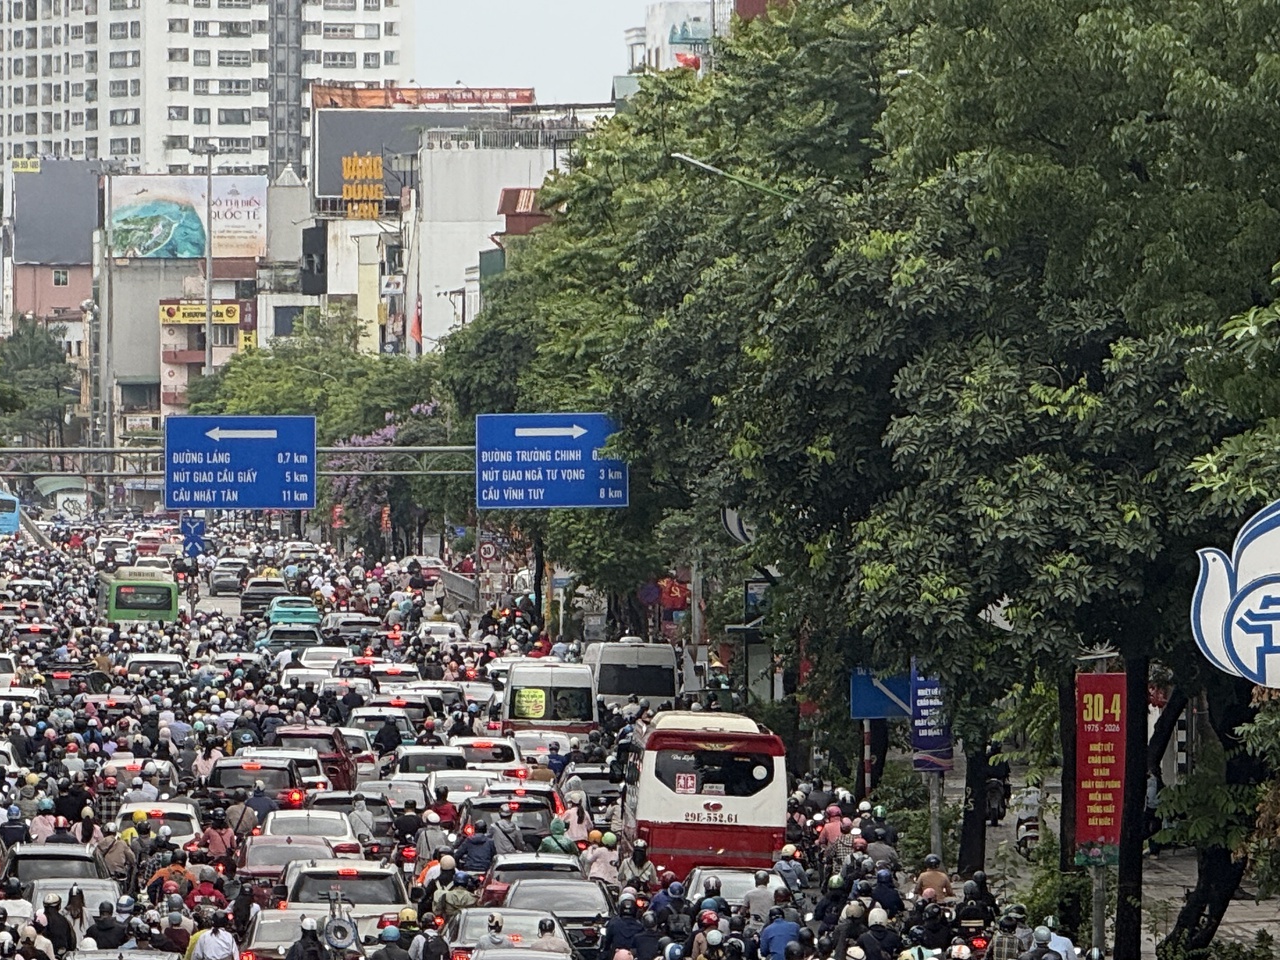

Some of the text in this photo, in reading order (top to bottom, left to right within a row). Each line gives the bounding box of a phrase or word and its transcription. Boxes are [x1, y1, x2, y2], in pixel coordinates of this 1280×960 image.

[172, 449, 308, 464] ĐƯỜNG LÁNG 0,7 km
[481, 447, 512, 462] ĐƯỜNG
[555, 450, 582, 461] CHINH
[173, 468, 191, 483] NÚT
[193, 472, 214, 483] GIAO
[285, 472, 291, 482] 5
[294, 472, 308, 482] km
[482, 466, 622, 482] NÚT GIAO NGÃ TƯ VỌNG 3 km
[173, 487, 191, 501] CẦU
[221, 489, 238, 501] TÂN
[282, 491, 291, 501] 11
[294, 491, 308, 501] km
[482, 486, 500, 500] CẦU
[528, 488, 545, 500] TUY
[599, 488, 605, 498] 8
[608, 488, 622, 498] km
[1084, 724, 1099, 732] 1975
